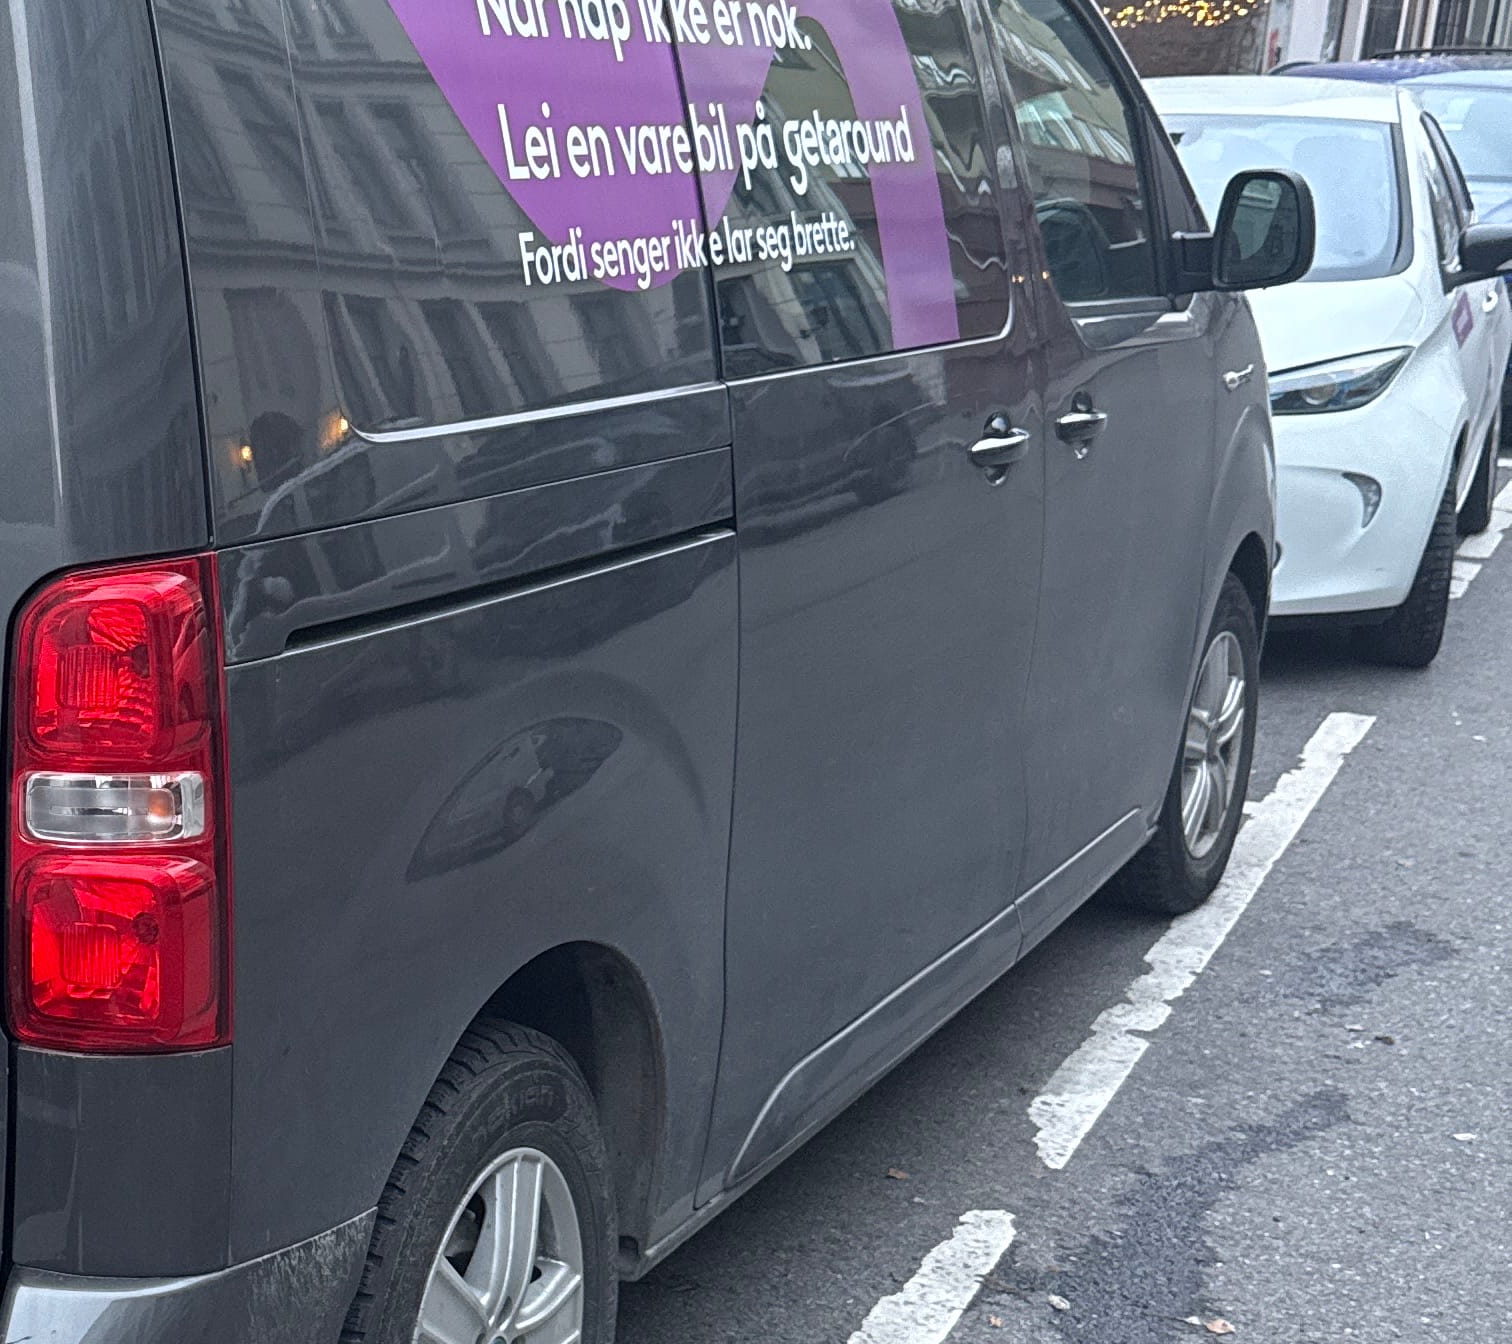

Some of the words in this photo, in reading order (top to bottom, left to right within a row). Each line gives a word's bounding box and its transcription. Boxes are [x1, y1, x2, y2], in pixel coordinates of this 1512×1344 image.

[497, 102, 561, 180] Lei
[566, 124, 615, 177] en
[616, 103, 734, 175] varebil
[738, 101, 776, 190] på
[782, 105, 915, 194] getaround
[518, 229, 588, 286] Fordi
[590, 235, 670, 290] senger
[723, 216, 754, 261] lar
[756, 231, 792, 272] seg
[790, 210, 855, 258] brette.
